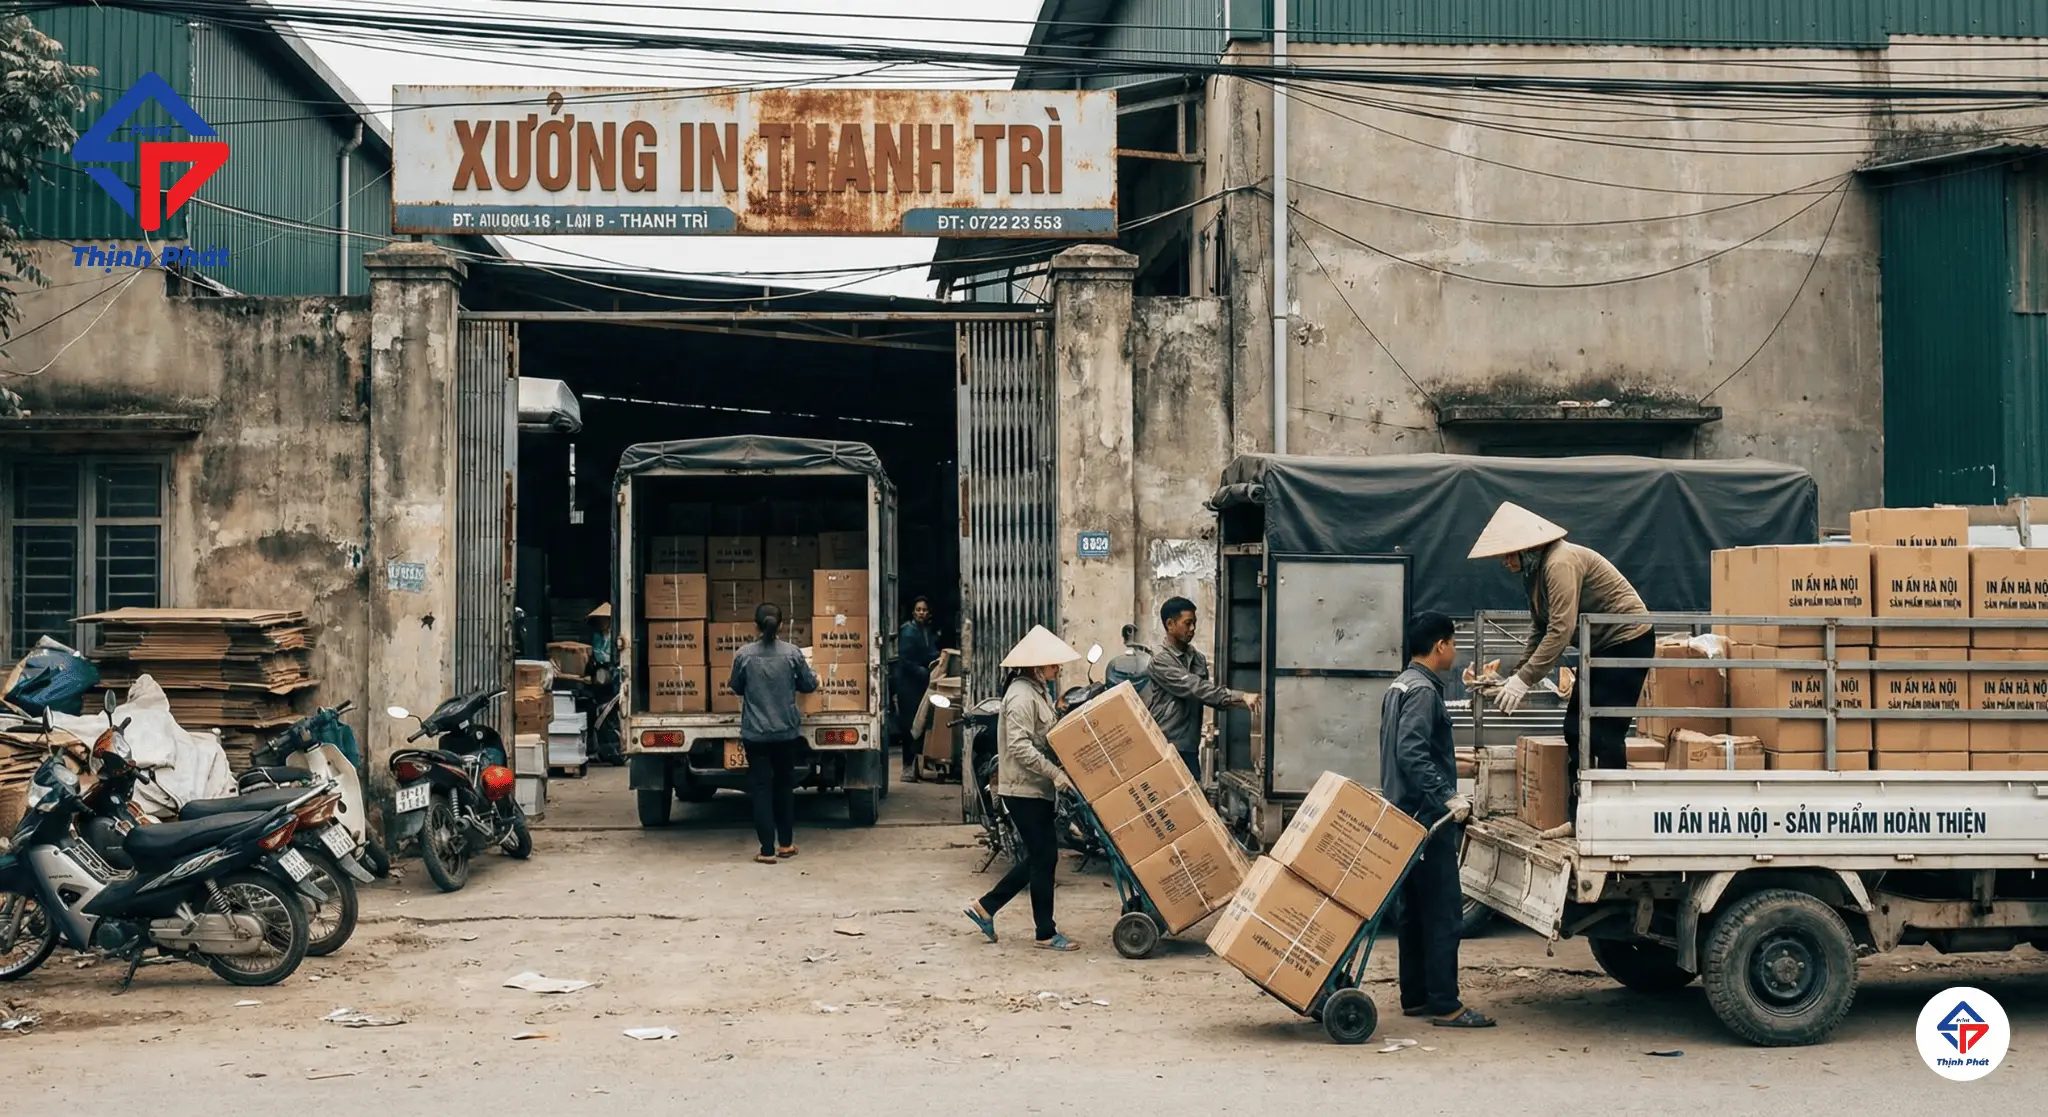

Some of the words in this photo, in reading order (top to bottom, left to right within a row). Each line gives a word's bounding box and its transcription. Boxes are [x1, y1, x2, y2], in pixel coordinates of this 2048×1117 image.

[453, 91, 658, 192] XƯỞNG
[680, 122, 739, 192] IN
[759, 123, 954, 194] THANH
[974, 106, 1063, 194] TRÌ
[453, 213, 474, 228] ĐT:
[596, 213, 604, 228] B
[620, 213, 676, 228] THANH
[682, 210, 708, 228] TRÌ
[938, 215, 964, 229] ĐT:
[969, 215, 1007, 229] 0722
[1011, 215, 1030, 229] 23
[1792, 579, 1802, 591] IN
[1824, 575, 1837, 591] HÀ
[1840, 575, 1858, 594] NỘI
[1891, 580, 1902, 592] IN
[1923, 577, 1937, 592] HÀ
[1940, 576, 1957, 595] NỘI
[1986, 581, 1997, 594] IN
[2018, 578, 2031, 594] HÀ
[2035, 579, 2048, 597] NỘ
[1791, 680, 1802, 693] IN
[1890, 681, 1901, 693] IN
[1922, 677, 1936, 693] HÀ
[1939, 678, 1957, 696] NỘI
[1984, 681, 1995, 694] IN
[2016, 678, 2029, 694] HÀ
[2033, 679, 2048, 697] NỘ
[1654, 812, 1672, 833] IN
[1678, 804, 1702, 833] ẤN
[1708, 807, 1732, 833] HÀ
[1738, 807, 1767, 838] NỘI
[1785, 804, 1821, 833] SẢN
[1827, 802, 1877, 833] PHẨM
[1884, 807, 1931, 833] HOÀN
[1937, 807, 1986, 838] THIỆN
